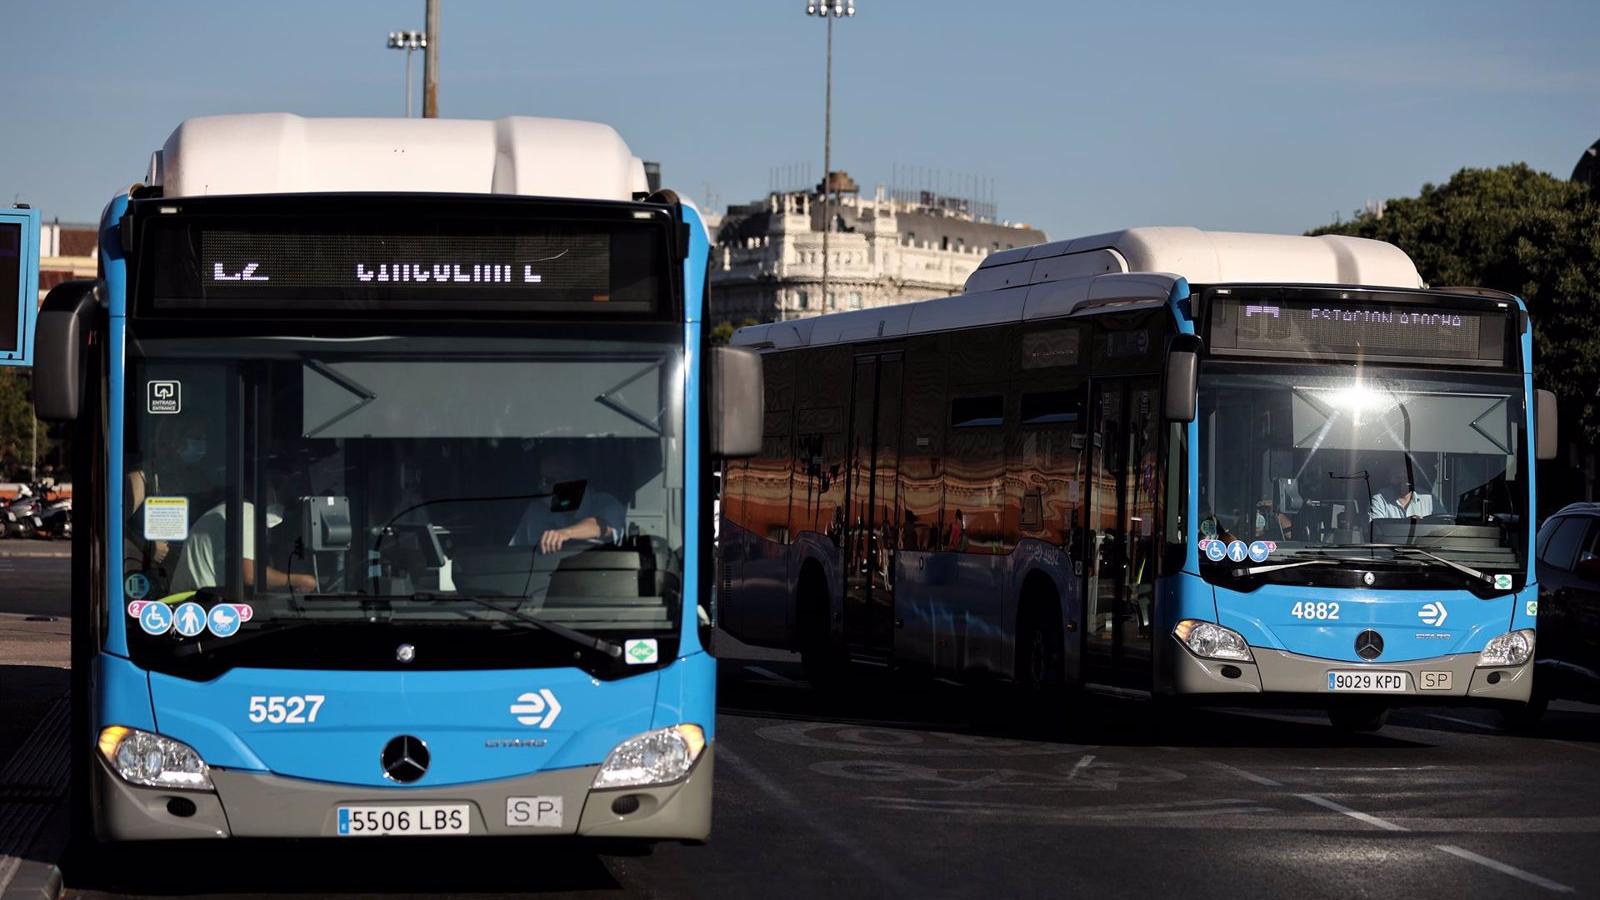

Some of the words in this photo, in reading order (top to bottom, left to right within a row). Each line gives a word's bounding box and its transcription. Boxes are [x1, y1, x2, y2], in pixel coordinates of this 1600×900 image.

[1292, 601, 1340, 620] 4882
[1336, 675, 1371, 688] 9029
[1376, 675, 1401, 688] KPD
[1425, 673, 1448, 688] SP
[249, 695, 325, 724] 5527
[353, 811, 411, 831] 5506
[420, 809, 464, 830] LBS
[513, 801, 555, 822] SP
